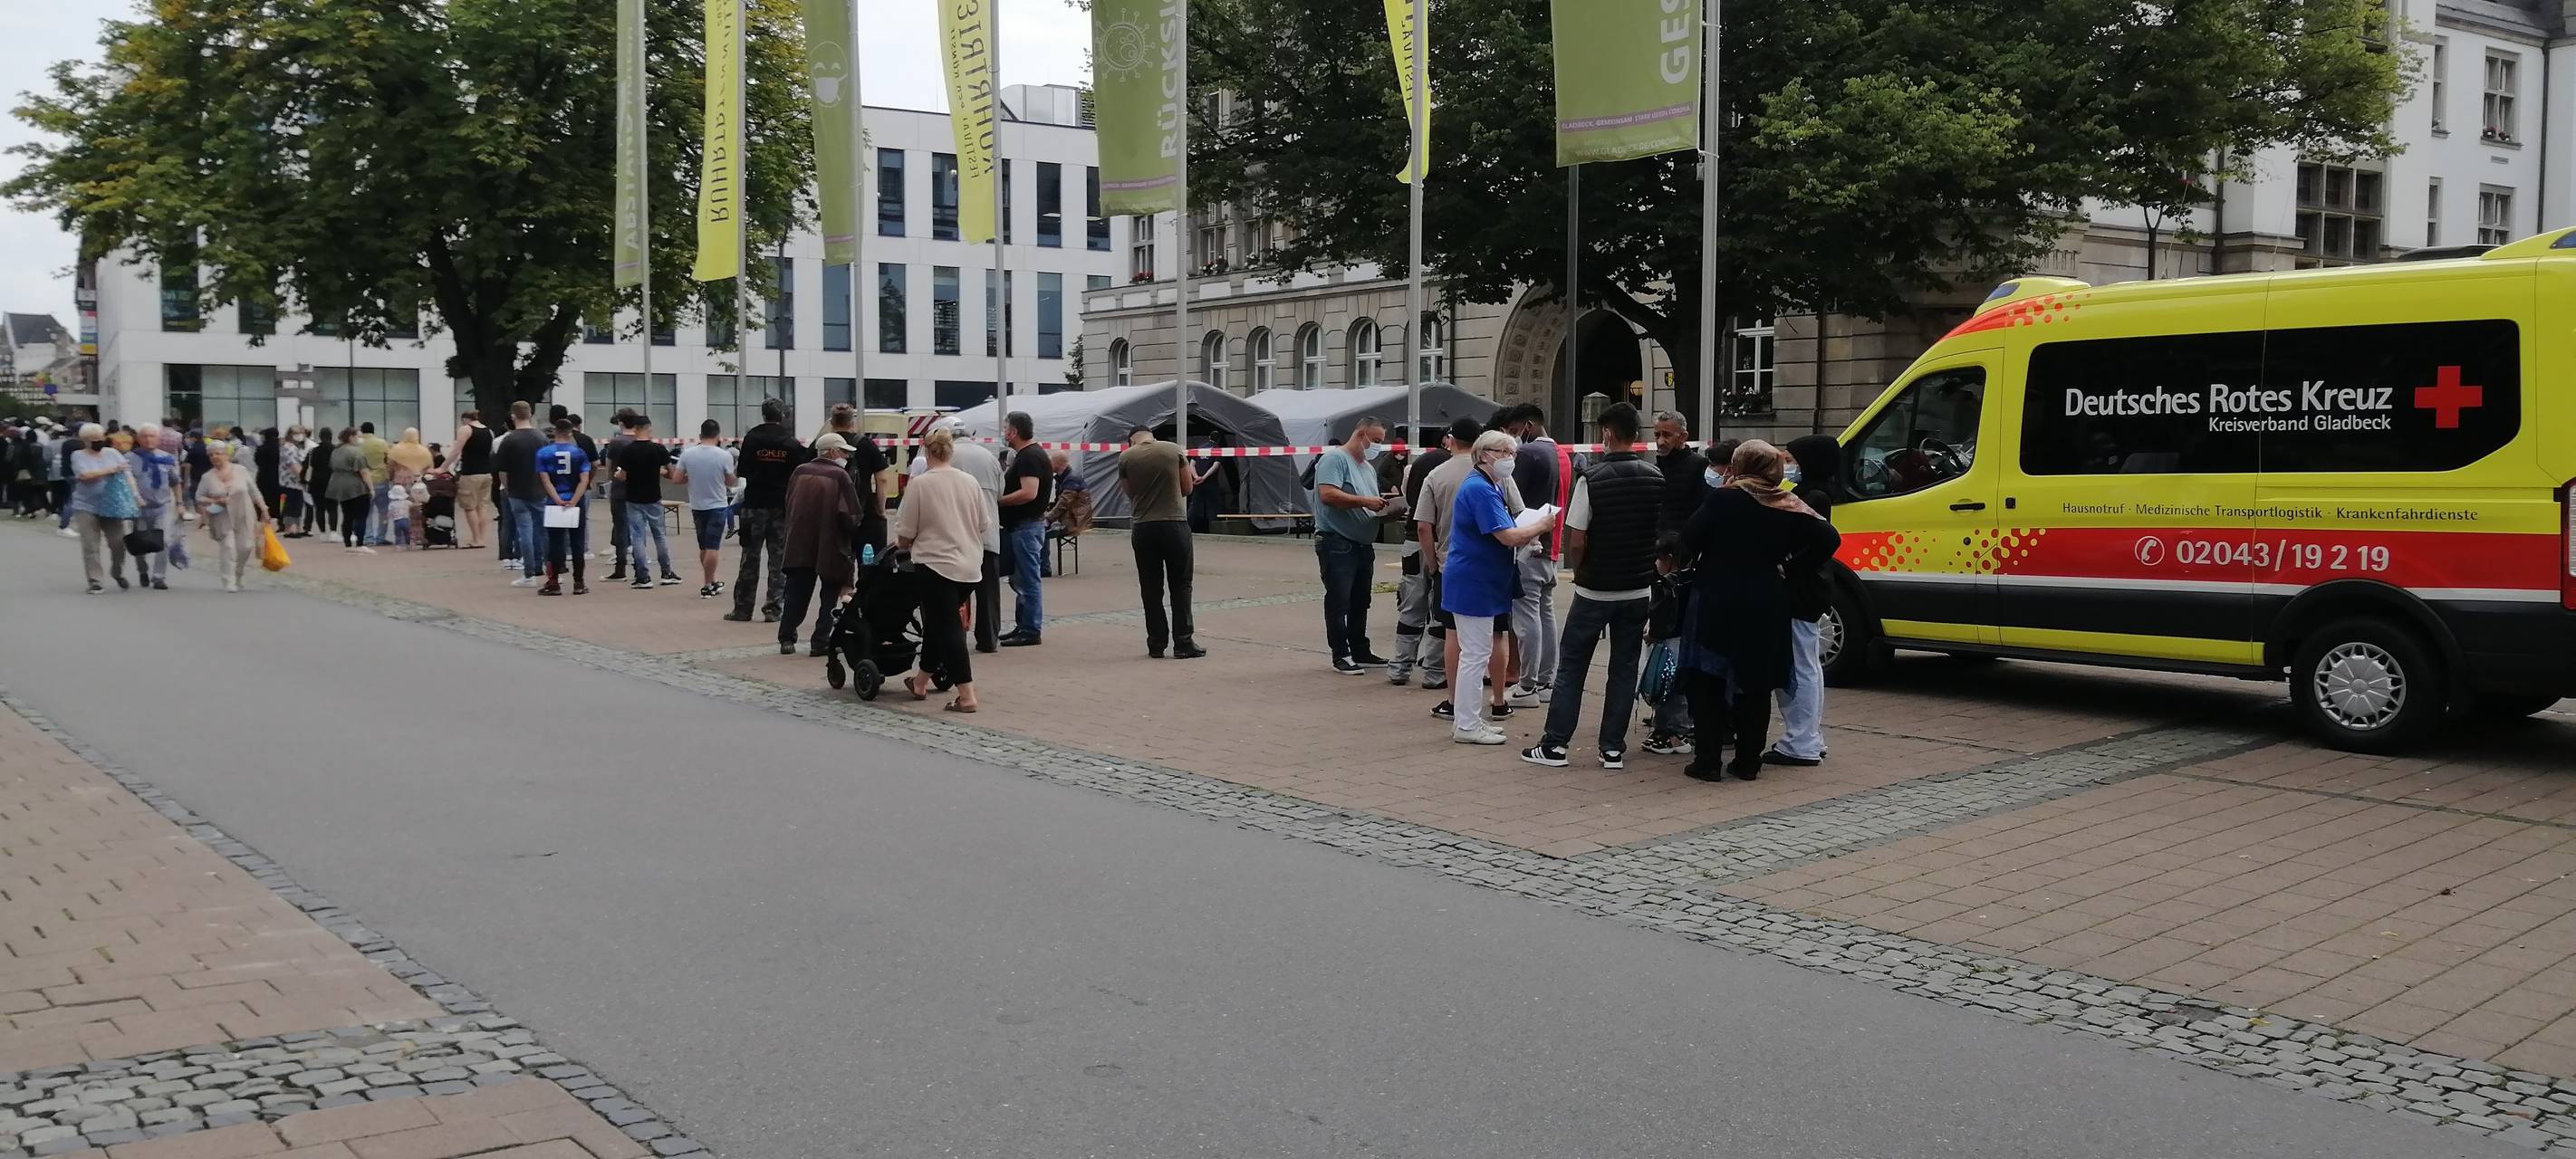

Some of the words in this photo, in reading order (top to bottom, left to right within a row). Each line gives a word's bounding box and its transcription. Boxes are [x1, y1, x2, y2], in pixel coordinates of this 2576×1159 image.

[2065, 386, 2200, 417] Deutsches
[2209, 384, 2292, 413] Rotes
[2302, 380, 2393, 411] Kreuz
[2209, 416, 2309, 433] Kreisverband
[2313, 414, 2391, 431] Gladbeck
[554, 451, 571, 474] 3
[2062, 503, 2125, 514] Hausnotruf
[2136, 503, 2211, 516] Medizinische
[2215, 504, 2322, 521] Transportlogistik
[2336, 506, 2478, 521] Krankenfahrdienste
[2330, 544, 2349, 570] 2
